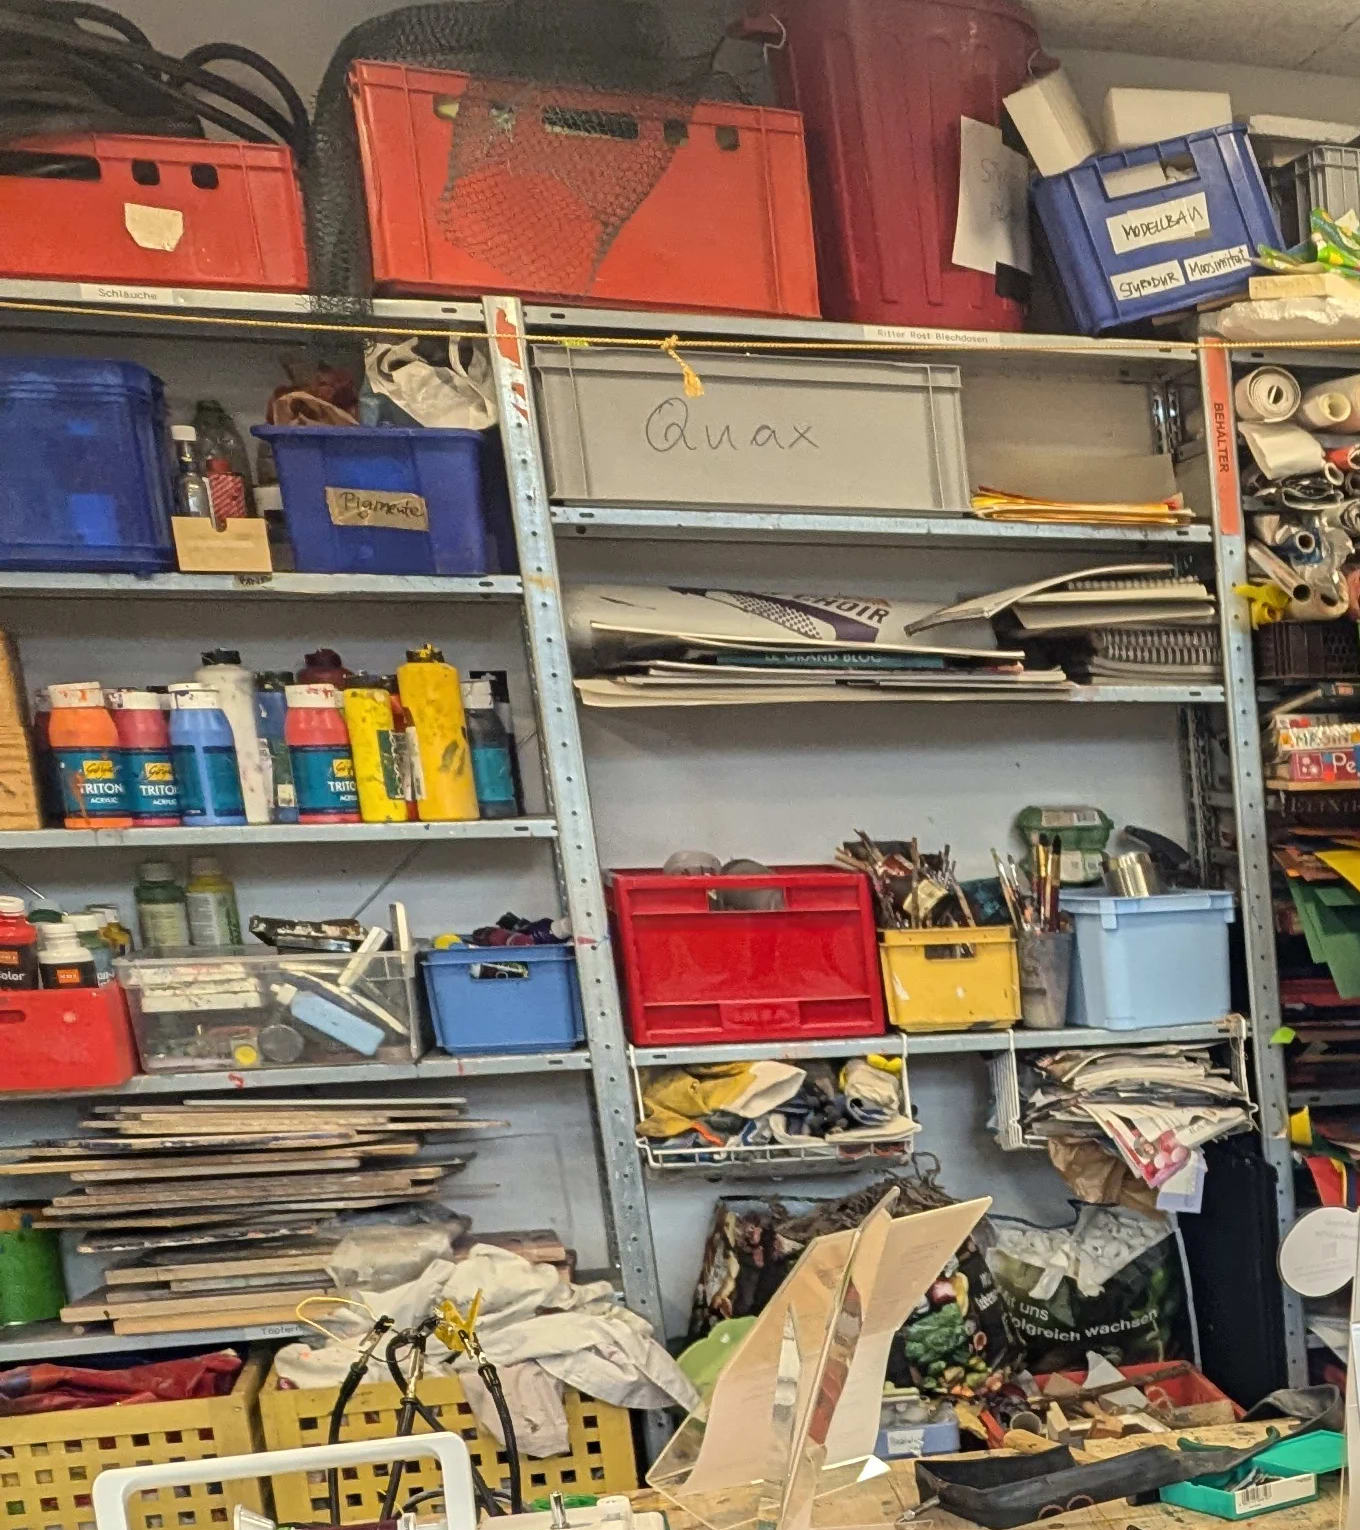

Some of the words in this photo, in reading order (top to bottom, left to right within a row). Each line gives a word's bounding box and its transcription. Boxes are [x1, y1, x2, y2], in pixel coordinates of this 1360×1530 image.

[646, 397, 819, 452] Quax
[140, 784, 176, 796] TRITO
[1085, 1309, 1158, 1338] wachsen
